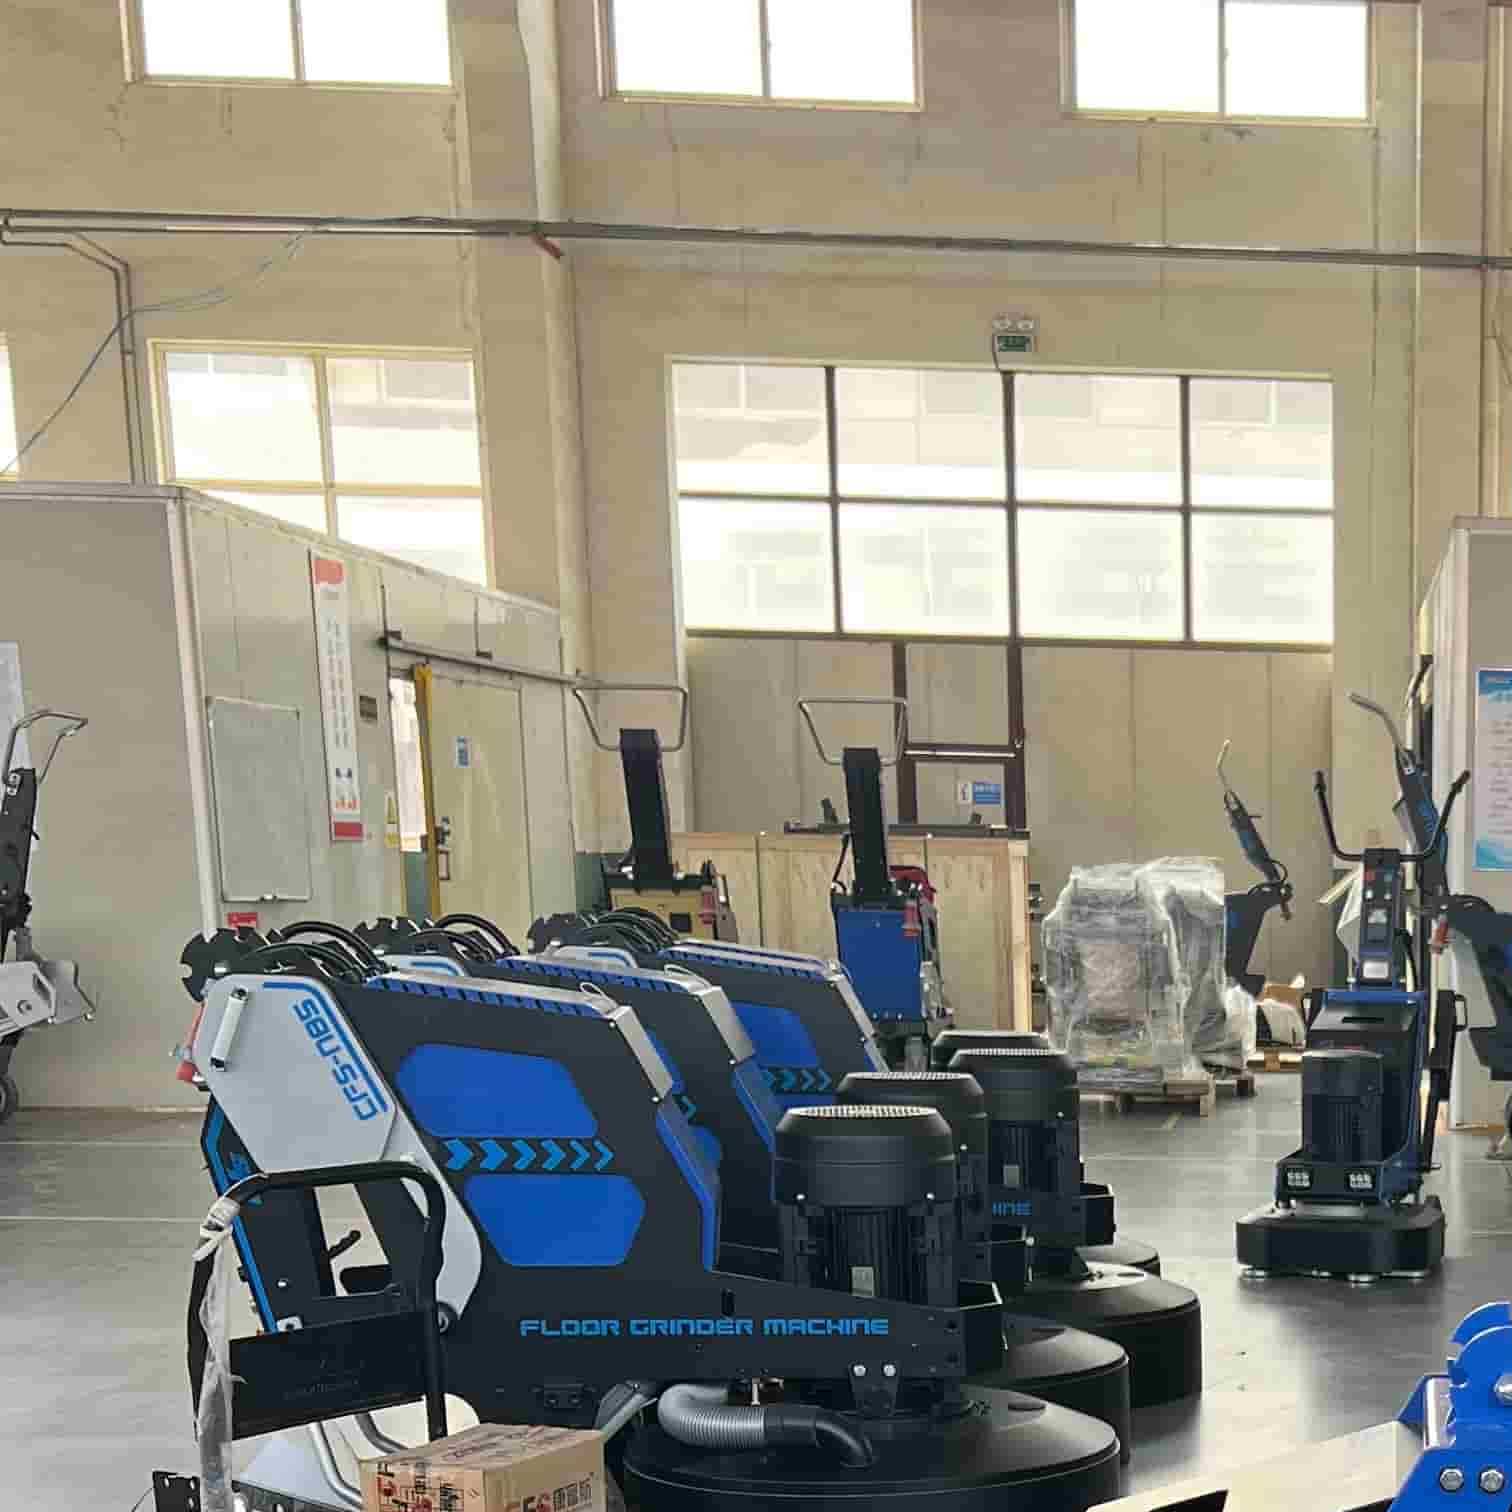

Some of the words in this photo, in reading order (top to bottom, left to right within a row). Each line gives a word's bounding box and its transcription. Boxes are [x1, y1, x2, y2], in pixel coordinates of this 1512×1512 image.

[520, 1318, 620, 1337] FLOOR
[630, 1318, 754, 1336] GRINDER
[763, 1318, 889, 1336] MACHINE
